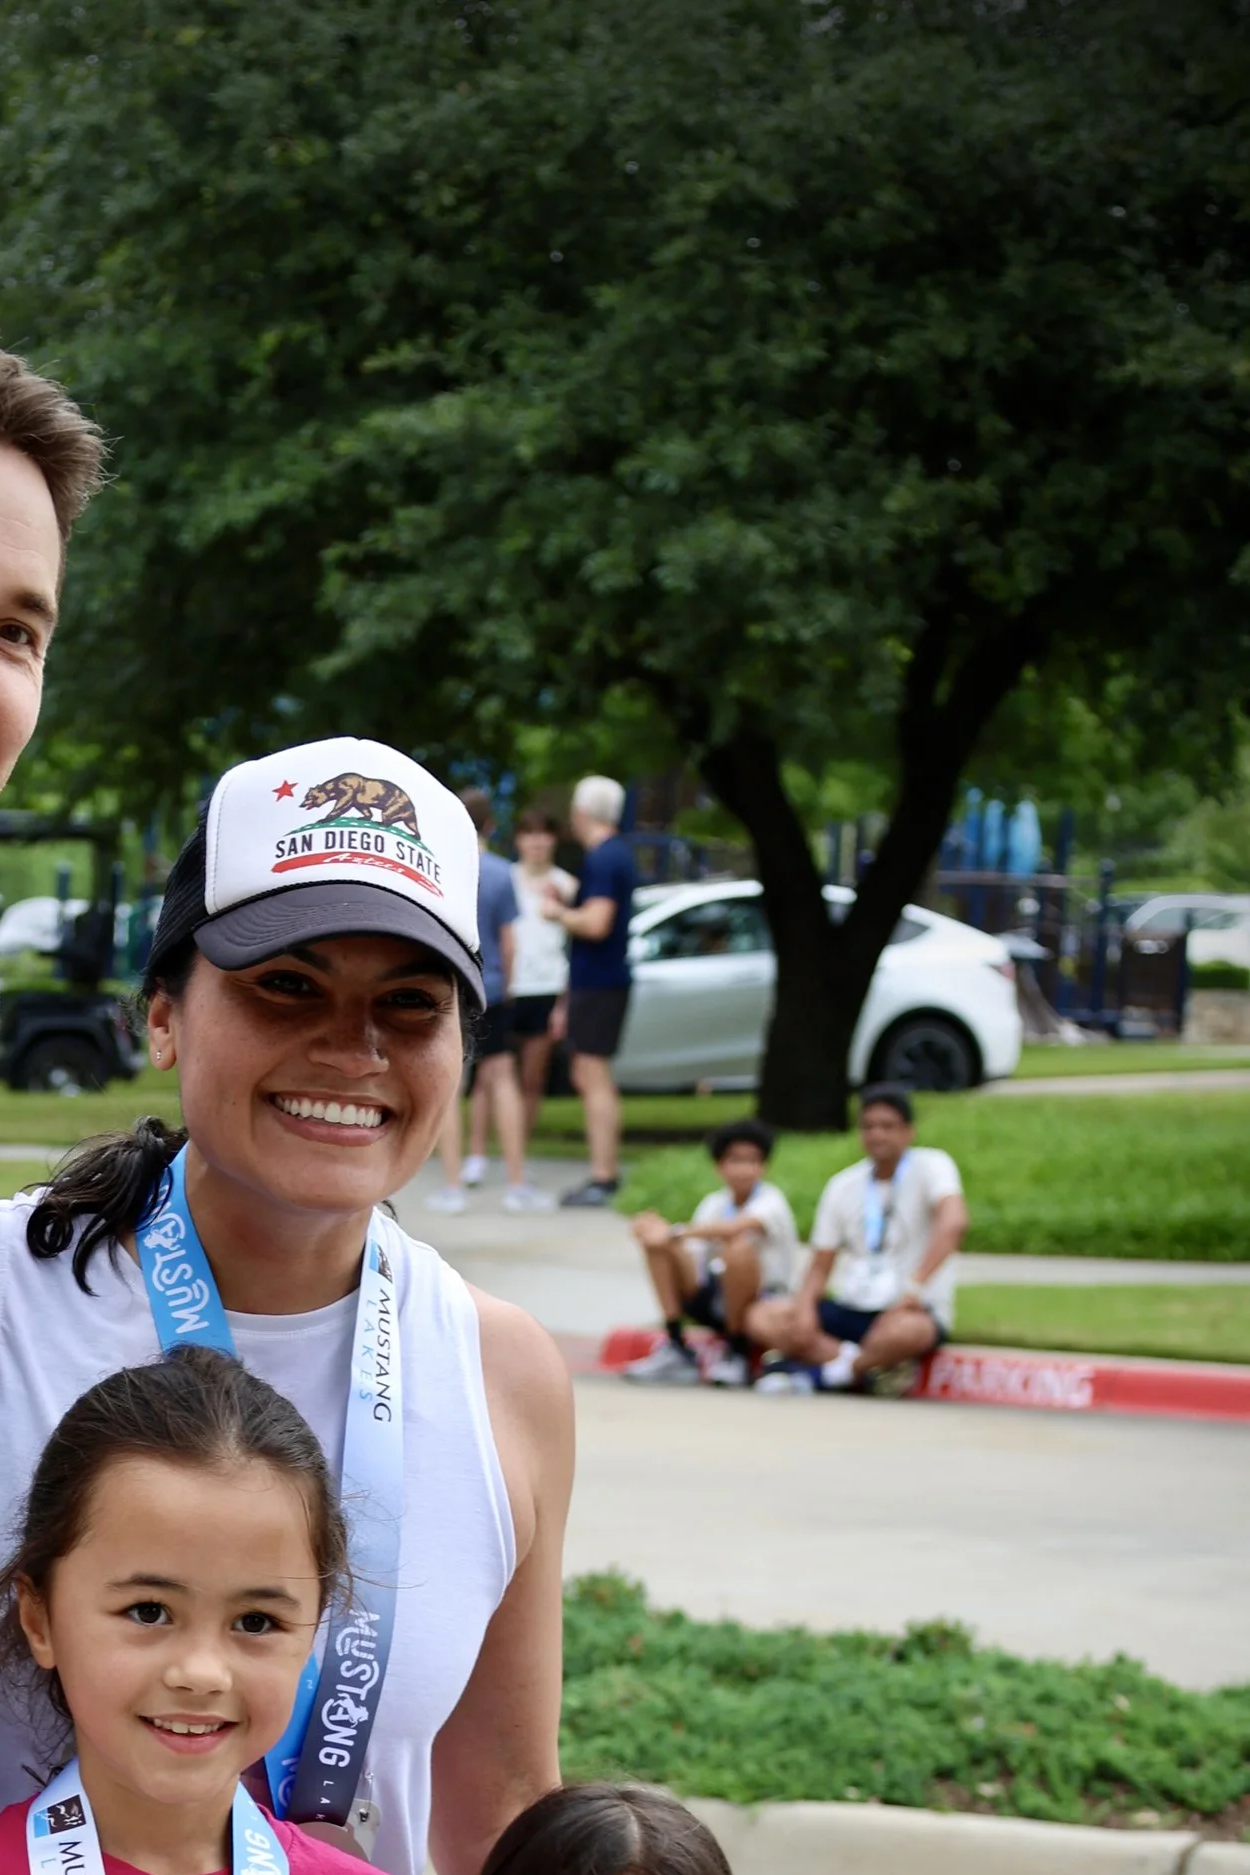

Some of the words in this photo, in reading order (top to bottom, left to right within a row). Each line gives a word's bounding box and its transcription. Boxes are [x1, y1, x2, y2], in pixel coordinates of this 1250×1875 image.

[275, 835, 313, 858] SAN
[325, 830, 385, 854] DIEGO
[396, 841, 441, 884] STATE
[359, 1300, 376, 1402] LAKES
[373, 1287, 393, 1424] MUSTANG
[318, 1608, 381, 1768] MUSTANG
[315, 1779, 334, 1820] LAK
